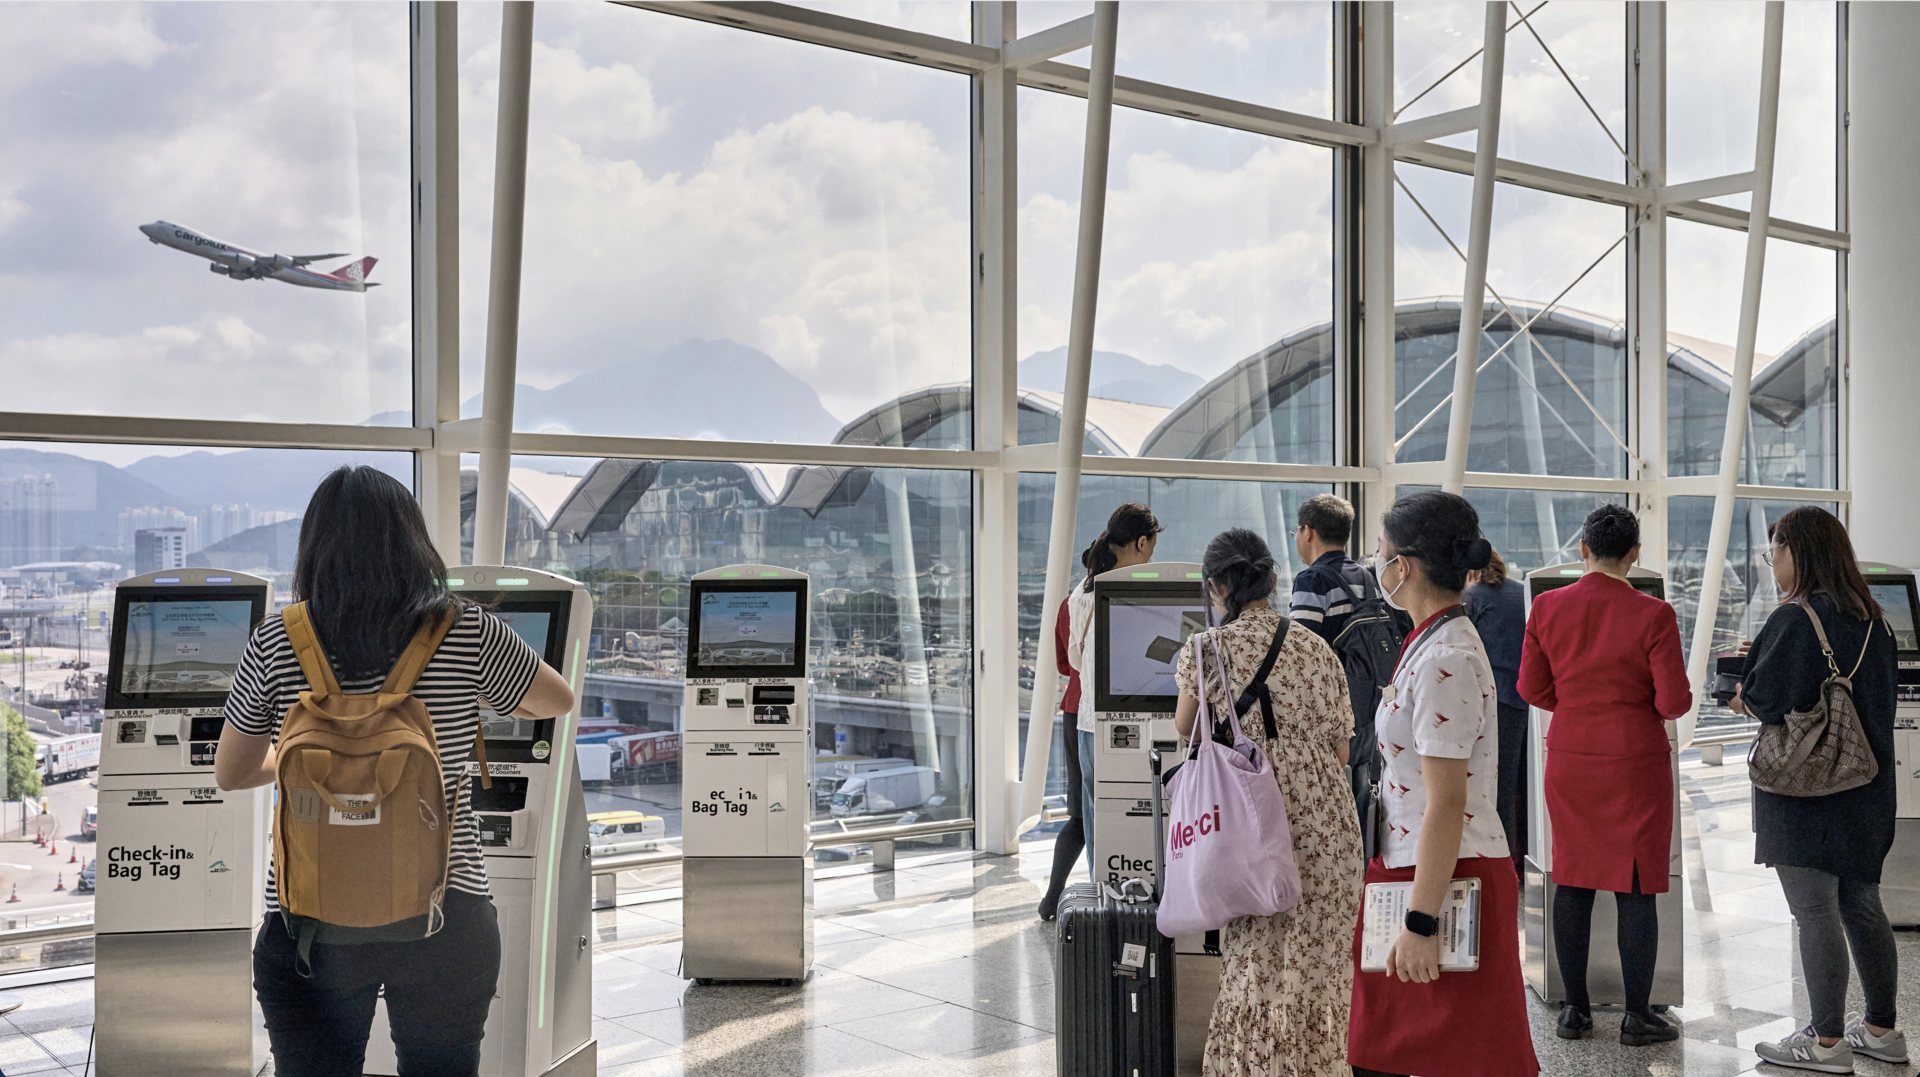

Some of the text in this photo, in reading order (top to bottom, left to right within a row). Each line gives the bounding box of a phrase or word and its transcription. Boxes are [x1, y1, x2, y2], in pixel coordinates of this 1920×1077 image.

[174, 228, 227, 251] cargolux
[472, 763, 518, 771] 放旅遊證件
[347, 800, 362, 808] THE
[692, 800, 747, 816] Bag Tag
[1170, 804, 1221, 851] Merci
[108, 861, 181, 882] Bag Tag
[1107, 854, 1153, 872] Chec
[1108, 872, 1143, 885] Ba
